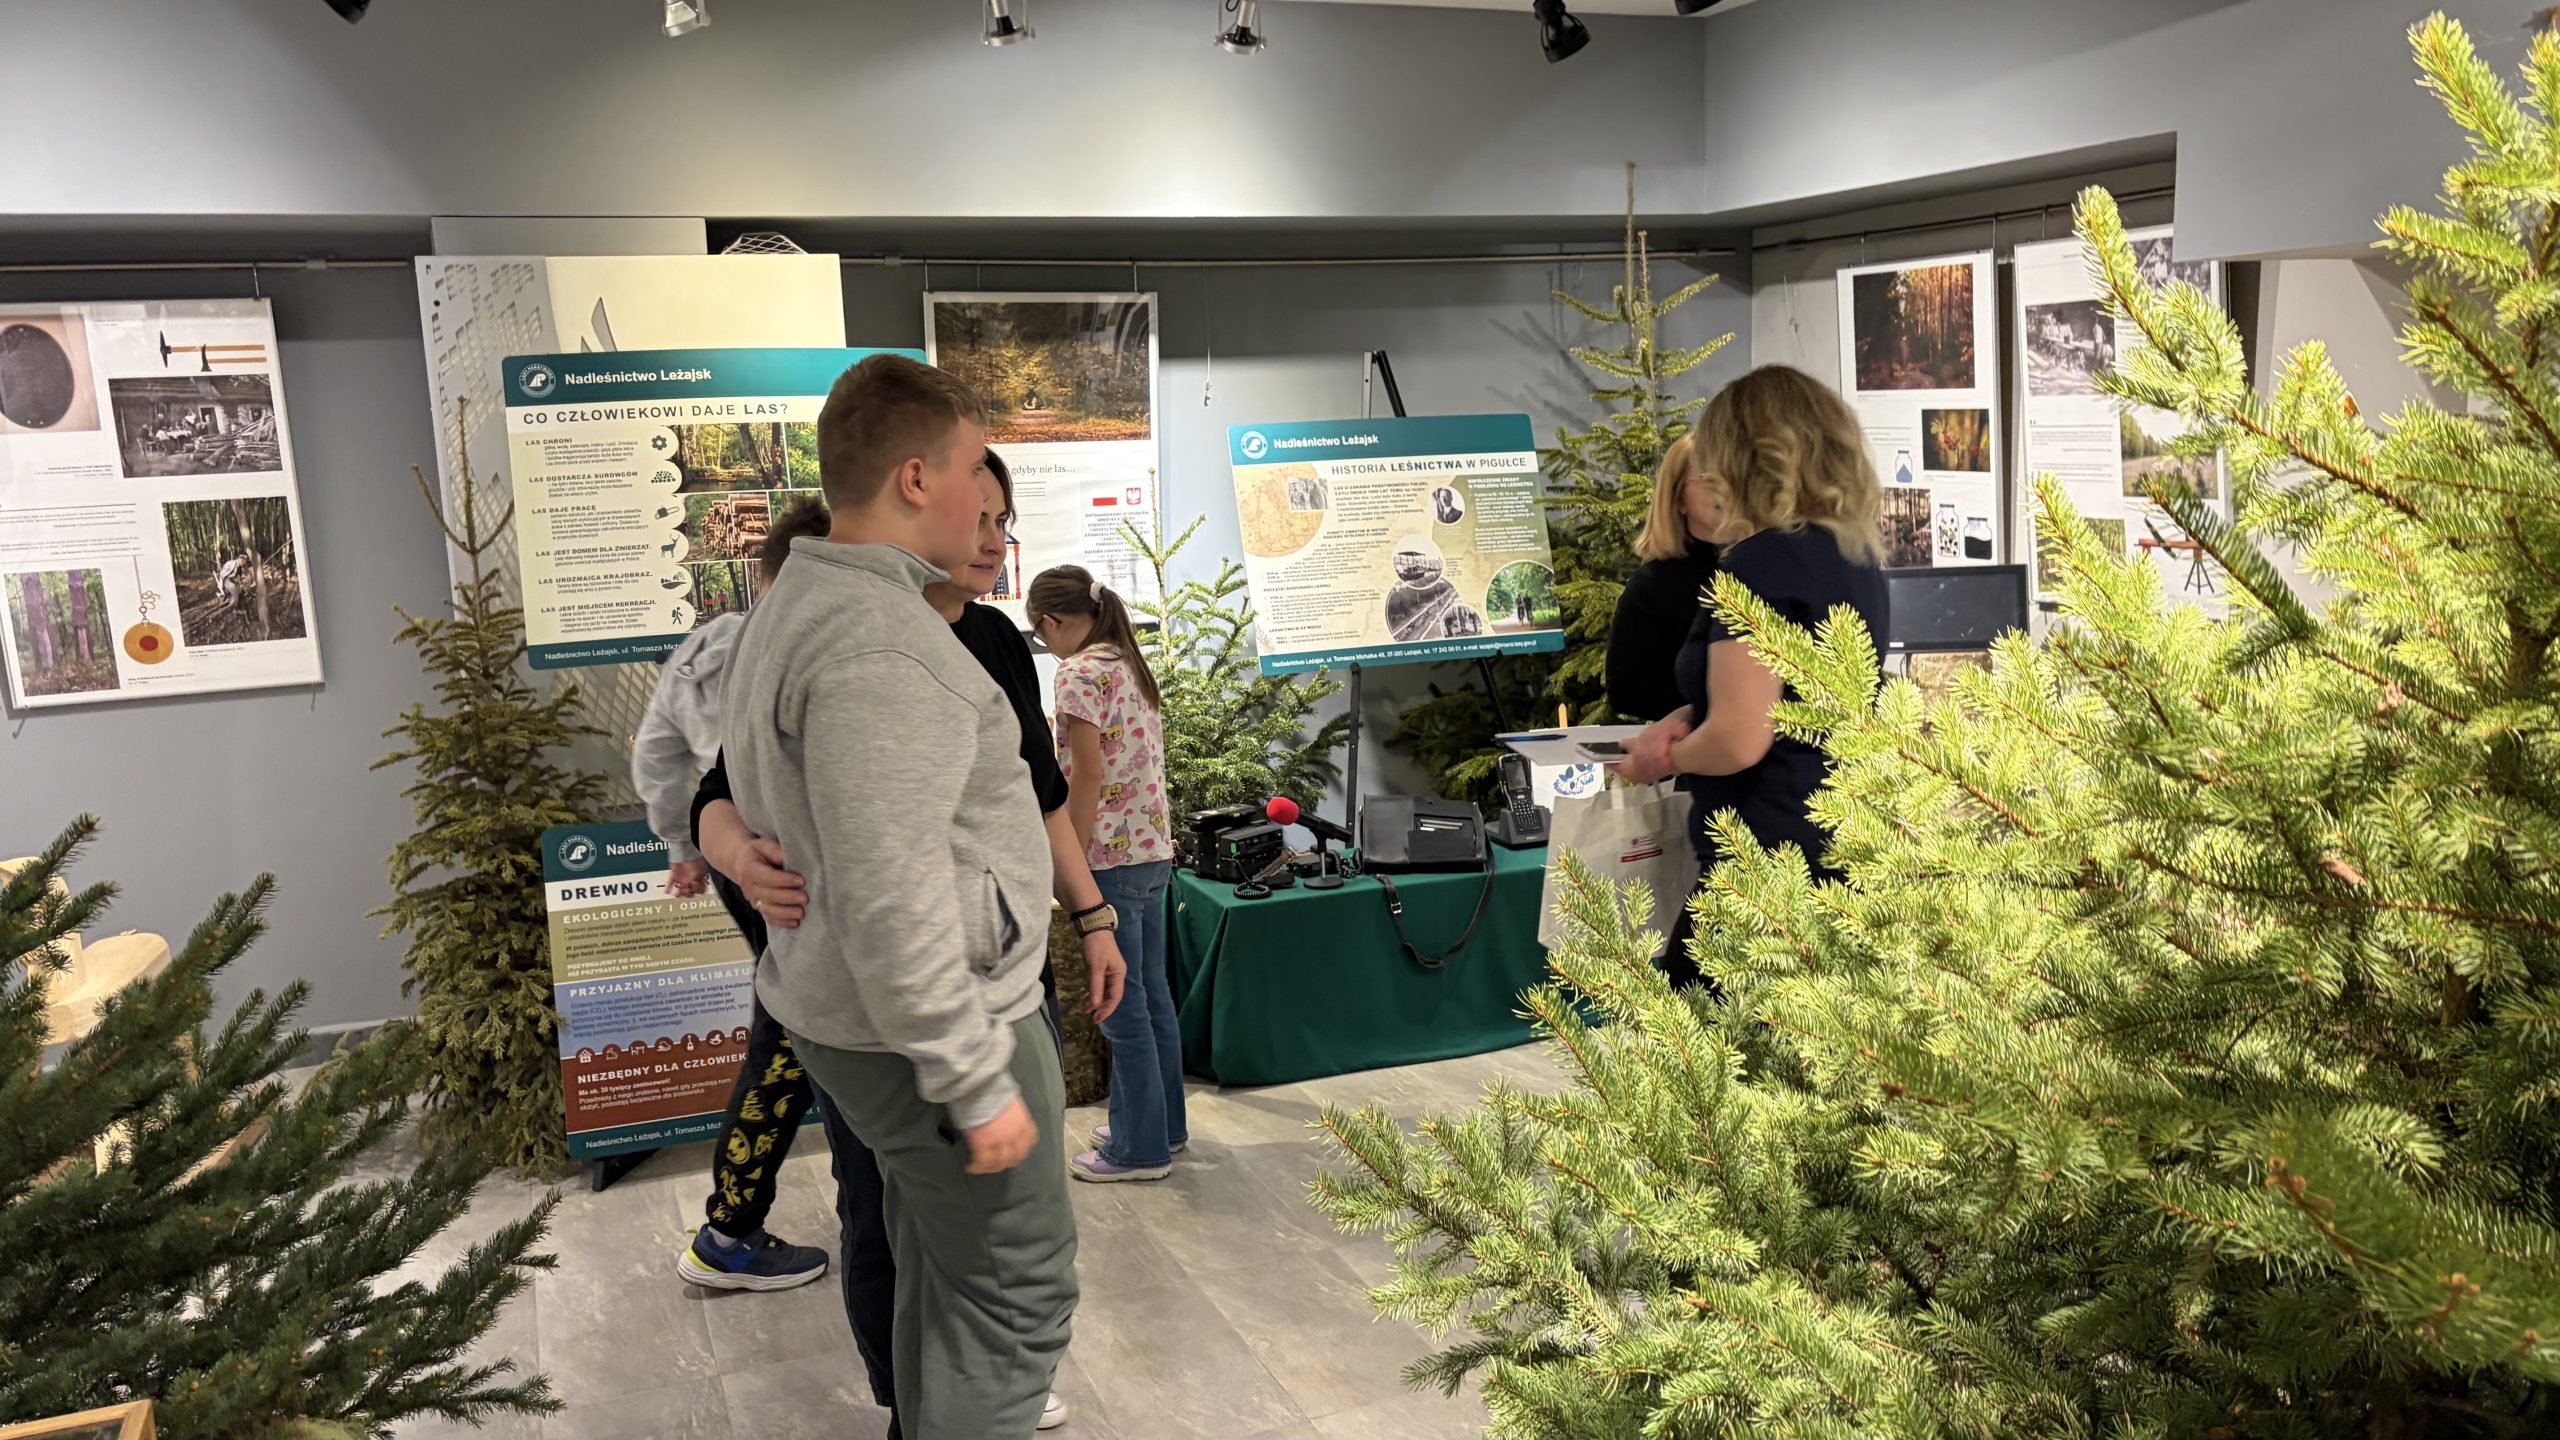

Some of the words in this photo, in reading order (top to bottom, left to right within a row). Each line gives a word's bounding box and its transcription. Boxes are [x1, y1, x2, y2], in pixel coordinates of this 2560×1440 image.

[564, 369, 656, 385] Nadleśnictwo
[660, 366, 712, 383] Leżajsk
[522, 411, 548, 424] CO
[556, 405, 682, 423] CZŁOWIEKOWI
[692, 403, 735, 416] DAJE
[744, 402, 788, 415] LAS?
[1272, 434, 1340, 448] Nadleśnictwo
[1341, 433, 1378, 447] Leżajsk
[1011, 465, 1038, 476] gdyby
[1039, 466, 1053, 474] nie
[1330, 463, 1386, 475] HISTORIA
[1390, 457, 1462, 472] LEŚNICTWA
[1466, 459, 1475, 469] W
[1480, 456, 1526, 468] PIGUŁCE
[546, 473, 592, 482] DOSTARCZA
[594, 469, 638, 479] SUROWCÓW
[554, 574, 601, 583] UROZMAICA
[577, 602, 613, 610] MIEJSCEM
[544, 649, 590, 660] Nadleśnictwo
[630, 644, 662, 653] Tomasza
[663, 643, 681, 651] Mich
[606, 837, 670, 856] Nadleśni
[560, 880, 648, 901] DREWNO
[562, 904, 662, 924] EKOLOGICZNY
[668, 903, 672, 913] I
[569, 980, 651, 998] PRZYJAZNY
[658, 976, 684, 987] DLA
[690, 968, 751, 983] KLIMATU
[577, 1066, 650, 1084] NIEZBĘDNY
[654, 1062, 680, 1073] DLA
[683, 1053, 747, 1069] CZŁOWIEK
[586, 1135, 632, 1148] Nadleśnictwo
[674, 1124, 704, 1135] Tomasza
[706, 1121, 724, 1130] Mich
